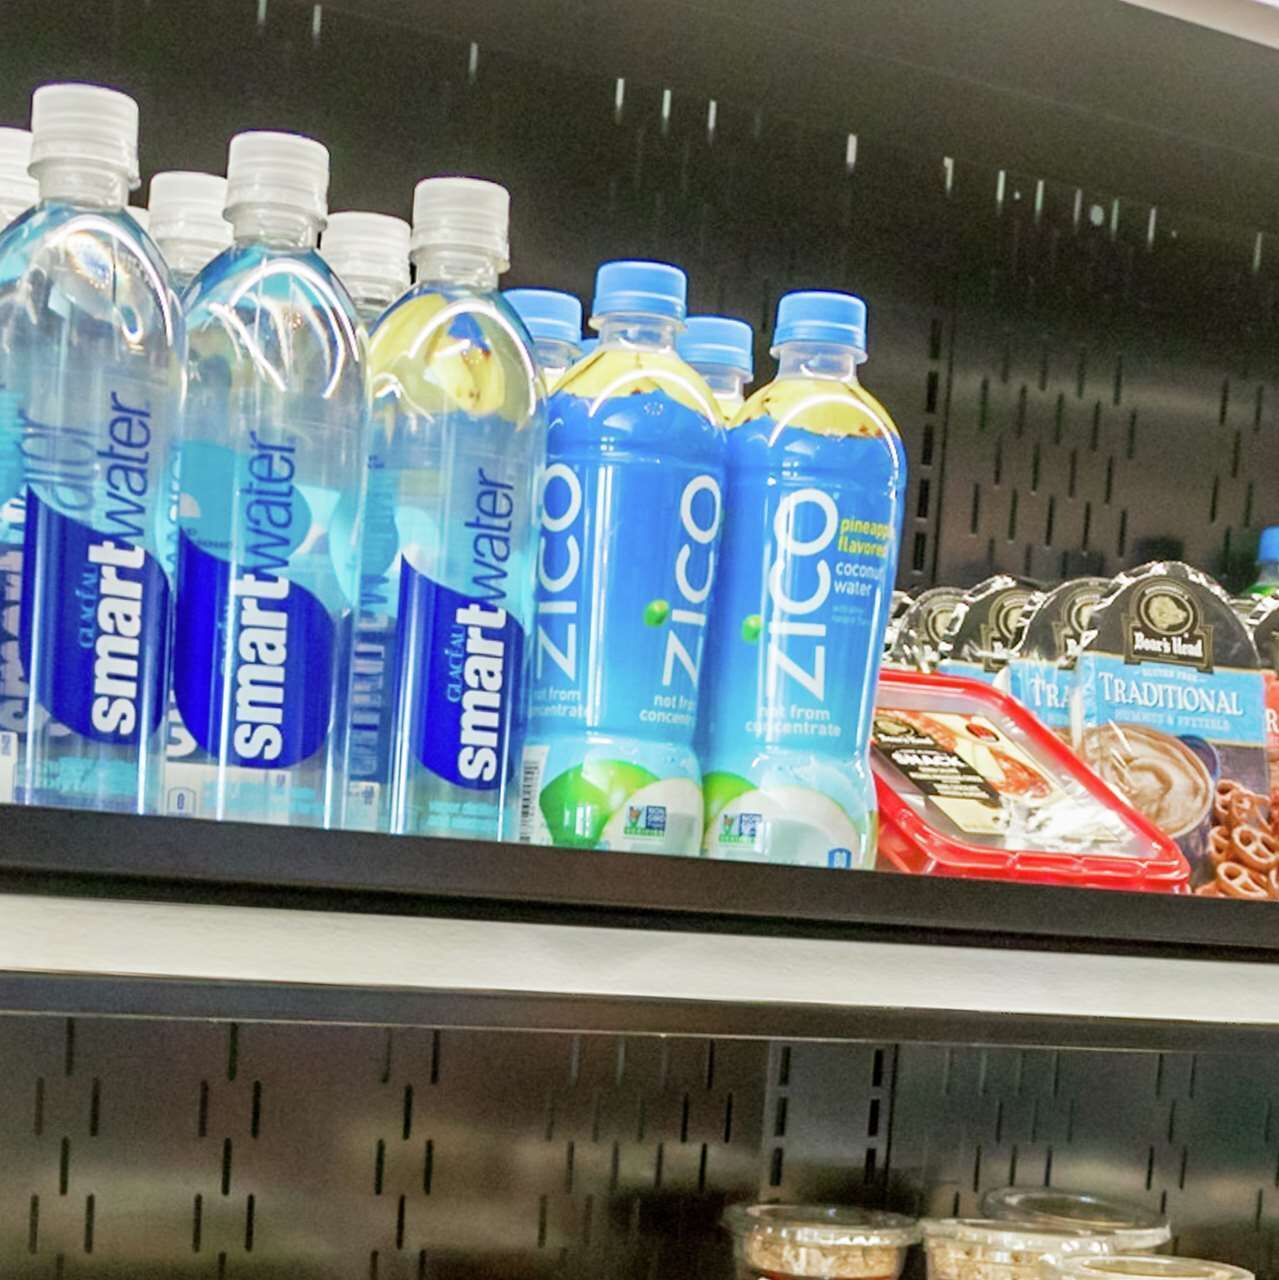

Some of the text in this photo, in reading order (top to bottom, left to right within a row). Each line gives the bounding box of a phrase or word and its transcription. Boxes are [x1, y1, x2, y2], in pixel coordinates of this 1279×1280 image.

[536, 463, 581, 680] ZICO
[662, 475, 722, 685] ZICO
[768, 487, 838, 701] ZICO
[834, 579, 872, 596] water
[1099, 672, 1243, 715] TRADITIONAL
